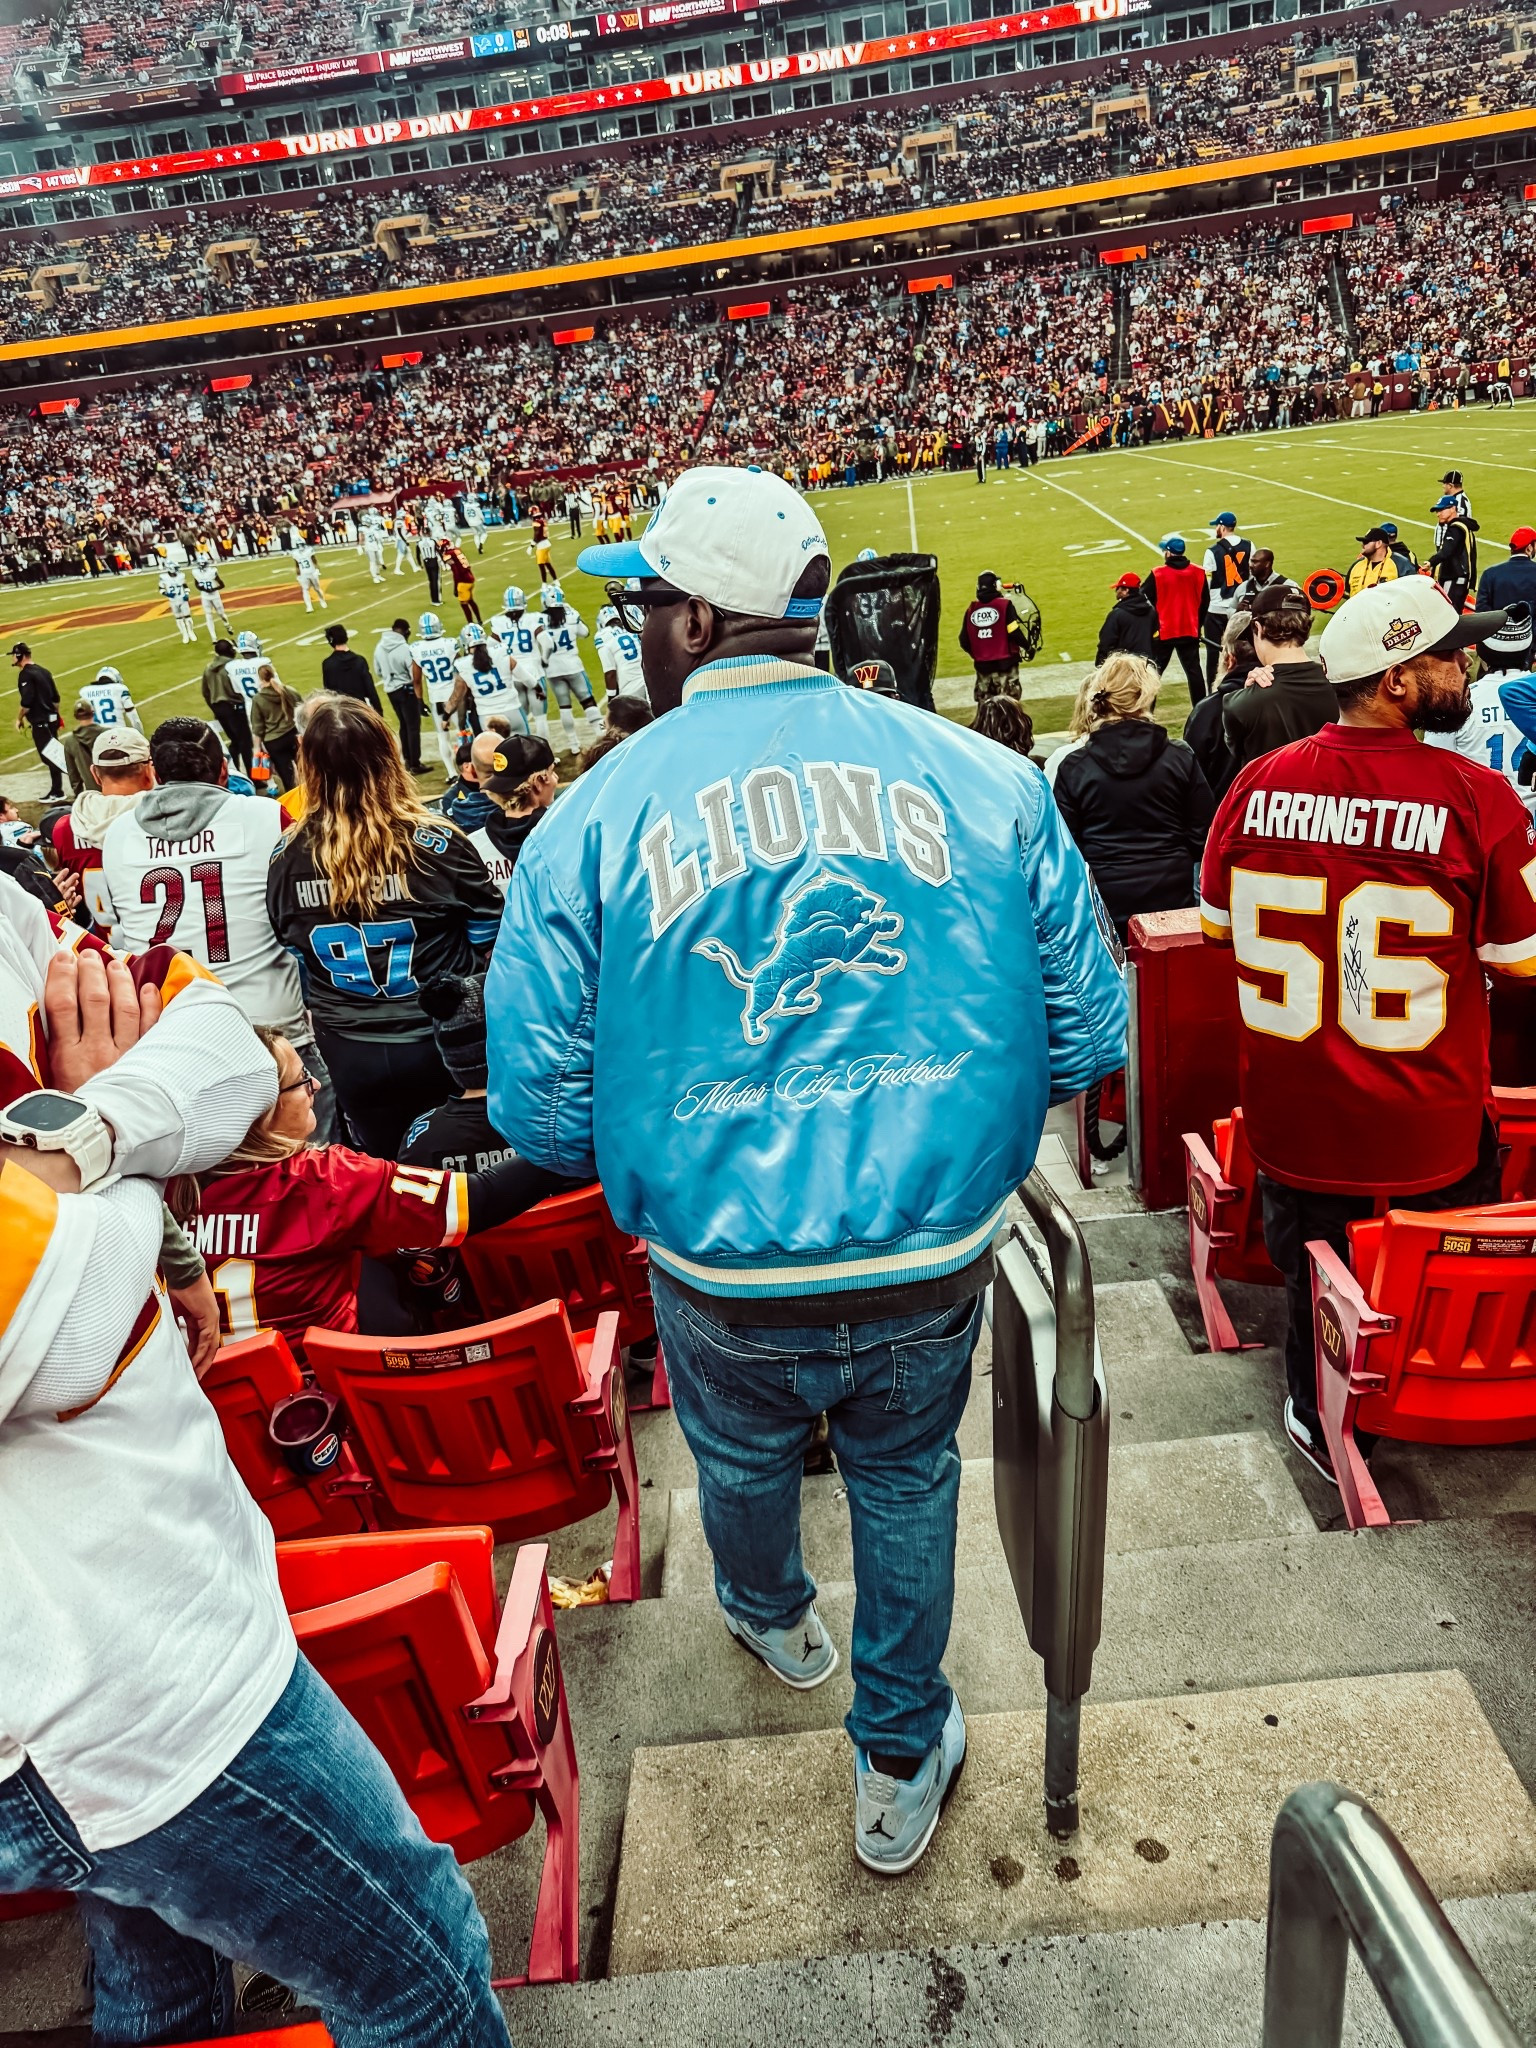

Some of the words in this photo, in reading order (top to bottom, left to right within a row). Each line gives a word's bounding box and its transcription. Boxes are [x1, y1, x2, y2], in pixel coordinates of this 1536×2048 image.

[494, 33, 505, 48] 0
[536, 22, 570, 44] 0:08
[411, 41, 465, 59] NORTHWEST
[255, 70, 277, 82] PRICE
[276, 65, 315, 79] BENOWITZ
[315, 60, 343, 73] INJURY
[341, 58, 358, 69] LAW
[664, 65, 743, 96] TURN
[750, 57, 791, 83] UP
[797, 42, 866, 75] DMV
[280, 128, 358, 156] TURN
[362, 120, 401, 146] UP
[408, 109, 473, 139] DMV
[976, 610, 993, 621] FOX
[501, 629, 534, 655] 78
[1385, 625, 1418, 648] DRAFT
[420, 655, 454, 684] 32
[472, 666, 508, 696] 51
[241, 676, 258, 700] 6
[1242, 790, 1449, 855] ARRINGTON
[145, 829, 216, 860] TAYLOR
[639, 760, 953, 943] LIONS
[139, 860, 231, 964] 21
[308, 917, 422, 999] 97
[1230, 866, 1455, 1053] 56
[673, 1075, 772, 1121] Motor
[774, 1064, 843, 1110] City
[846, 1050, 975, 1094] Football
[313, 1437, 338, 1463] PEPSI
